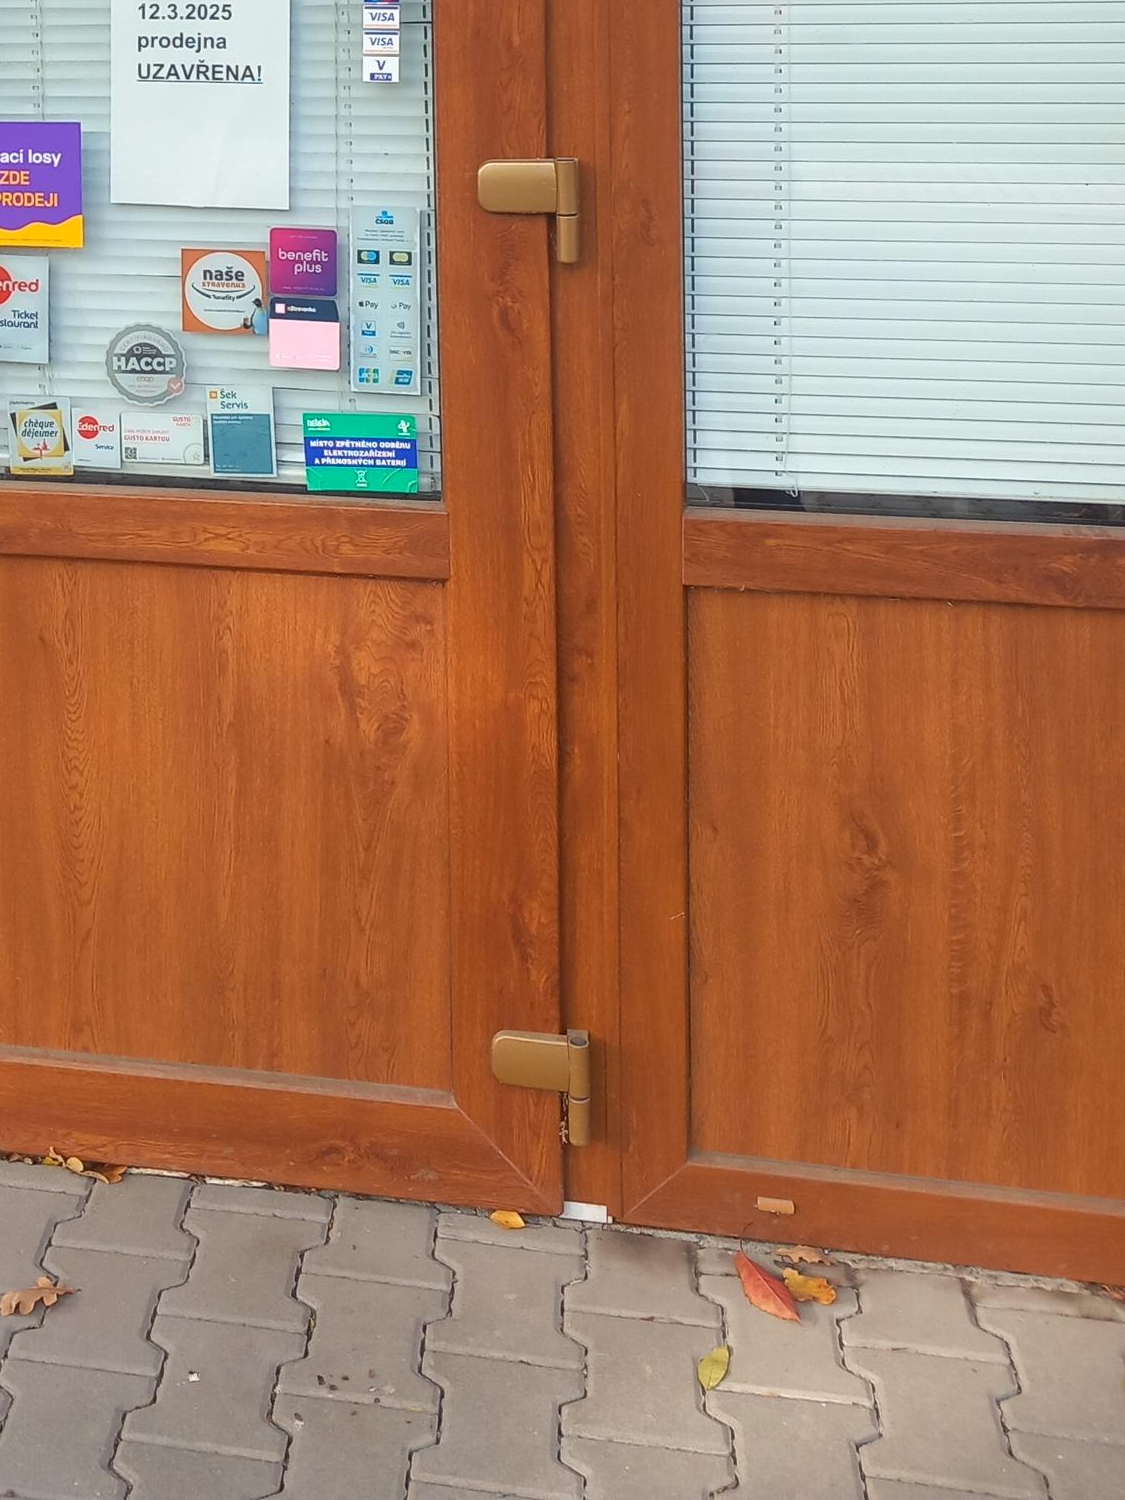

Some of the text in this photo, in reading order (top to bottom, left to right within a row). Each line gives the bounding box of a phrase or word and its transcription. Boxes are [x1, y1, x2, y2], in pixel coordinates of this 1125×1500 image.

[138, 3, 232, 20] 12.3.2025
[369, 12, 395, 22] VISA
[137, 32, 227, 53] prodejna
[369, 37, 394, 46] VISA
[137, 59, 262, 82] UZAVŘENA!
[375, 60, 386, 71] V
[28, 149, 62, 168] losy
[278, 247, 329, 262] benefit
[203, 266, 245, 282] naše
[294, 262, 322, 275] plus
[360, 276, 377, 284] VISA
[392, 278, 410, 286] VISA
[364, 300, 379, 309] Pay
[398, 302, 411, 311] Pay
[11, 309, 39, 320] Ticket
[112, 355, 177, 372] HACCP
[219, 388, 237, 399] Šek
[220, 401, 249, 410] Servis
[23, 418, 55, 429] chèque
[78, 421, 115, 432] Edenred
[21, 428, 59, 439] déjeuner
[310, 439, 334, 447] MÍSTO
